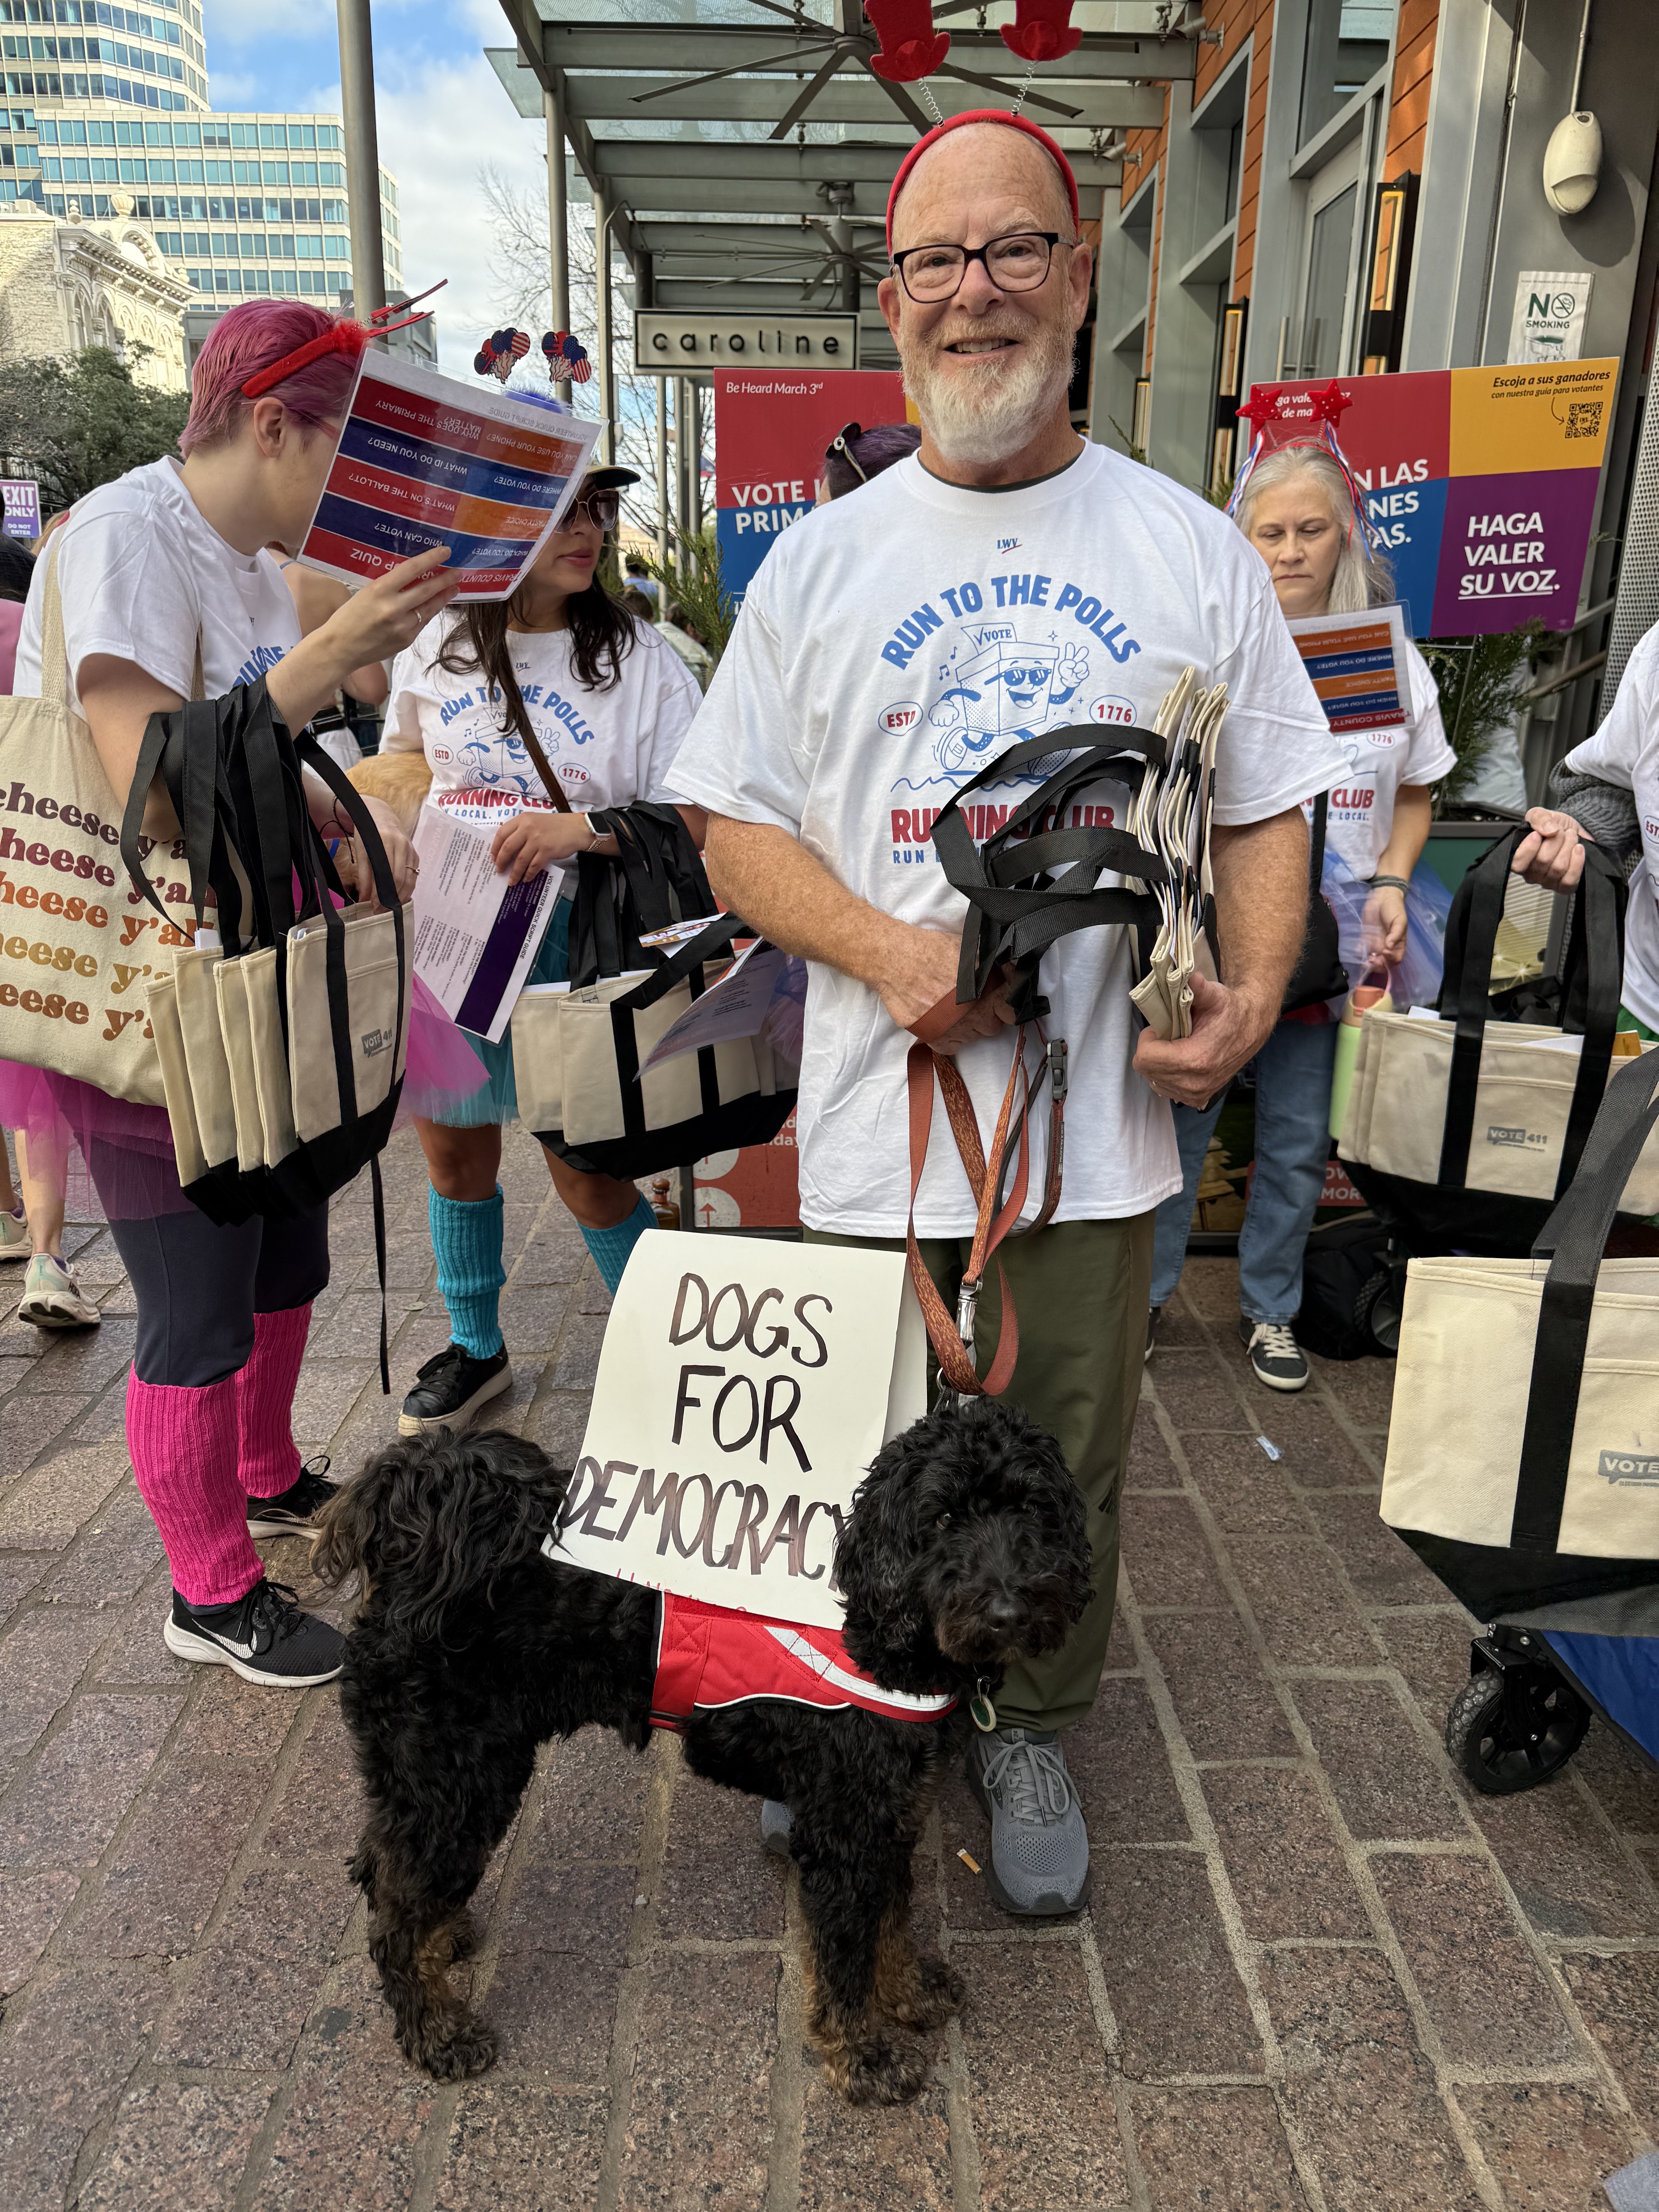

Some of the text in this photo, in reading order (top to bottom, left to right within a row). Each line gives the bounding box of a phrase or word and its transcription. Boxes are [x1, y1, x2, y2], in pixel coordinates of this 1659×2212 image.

[1526, 320, 1570, 329] SMOKING
[652, 330, 839, 354] caroline
[726, 382, 823, 394] Be Heard March 3rd
[1493, 376, 1525, 387] Escoja
[1537, 376, 1553, 384] sus
[1556, 371, 1611, 385] ganadores
[1553, 388, 1570, 396] para
[1572, 384, 1603, 393] votantes
[375, 399, 479, 440] WHY DOES THE PRIMARY
[1282, 408, 1295, 418] de
[443, 416, 481, 433] MATTER?
[367, 436, 468, 475] WHAT ID DO YOU NEED?
[486, 433, 577, 462] CAN YOU USE YOUR PHONE?
[494, 476, 516, 487] VOTE?
[1381, 459, 1428, 488] LAS
[348, 472, 455, 512] WHAT'S ON THE BALLOT?
[517, 481, 531, 489] YOU
[542, 486, 561, 495] WHERE
[732, 481, 805, 507] VOTE
[2, 486, 34, 506] EXIT
[5, 507, 35, 517] ONLY
[505, 516, 527, 525] CHOICE
[1468, 512, 1544, 538] HAGA
[374, 522, 443, 548] WHO CAN VOTE?
[997, 538, 1018, 549] LWV
[350, 548, 383, 567] QUIZ
[1464, 542, 1544, 566] VALER
[493, 572, 521, 582] TRAVIS
[1459, 569, 1560, 595] SU VOZ.
[881, 574, 1141, 670] RUN TO THE POLLS
[984, 629, 1012, 642] VOTE
[440, 692, 474, 726] RUN
[543, 692, 594, 745] POLLS
[1097, 704, 1132, 723] 1776
[1333, 710, 1410, 726] TRAVIS COUNTY
[1372, 733, 1392, 744] 1776
[434, 749, 586, 781] ESTD 1776
[438, 788, 520, 807] RUNNING
[1331, 789, 1374, 809] CLUB
[455, 809, 491, 819] LOCAL.
[1339, 812, 1369, 821] LOCAL.
[1646, 821, 1659, 837] EST
[0, 827, 115, 887] heese
[893, 850, 924, 864] RUN
[519, 875, 554, 959] VOLUNTEER QUICK SCRIPT GUIDE
[0, 934, 98, 977] eese
[0, 984, 89, 1025] eese
[364, 1034, 381, 1048] VOTE
[1491, 1129, 1547, 1144] VOTE 411
[1321, 1187, 1359, 1200] MOR
[669, 1272, 833, 1368] DOGS
[671, 1364, 812, 1472] FOR
